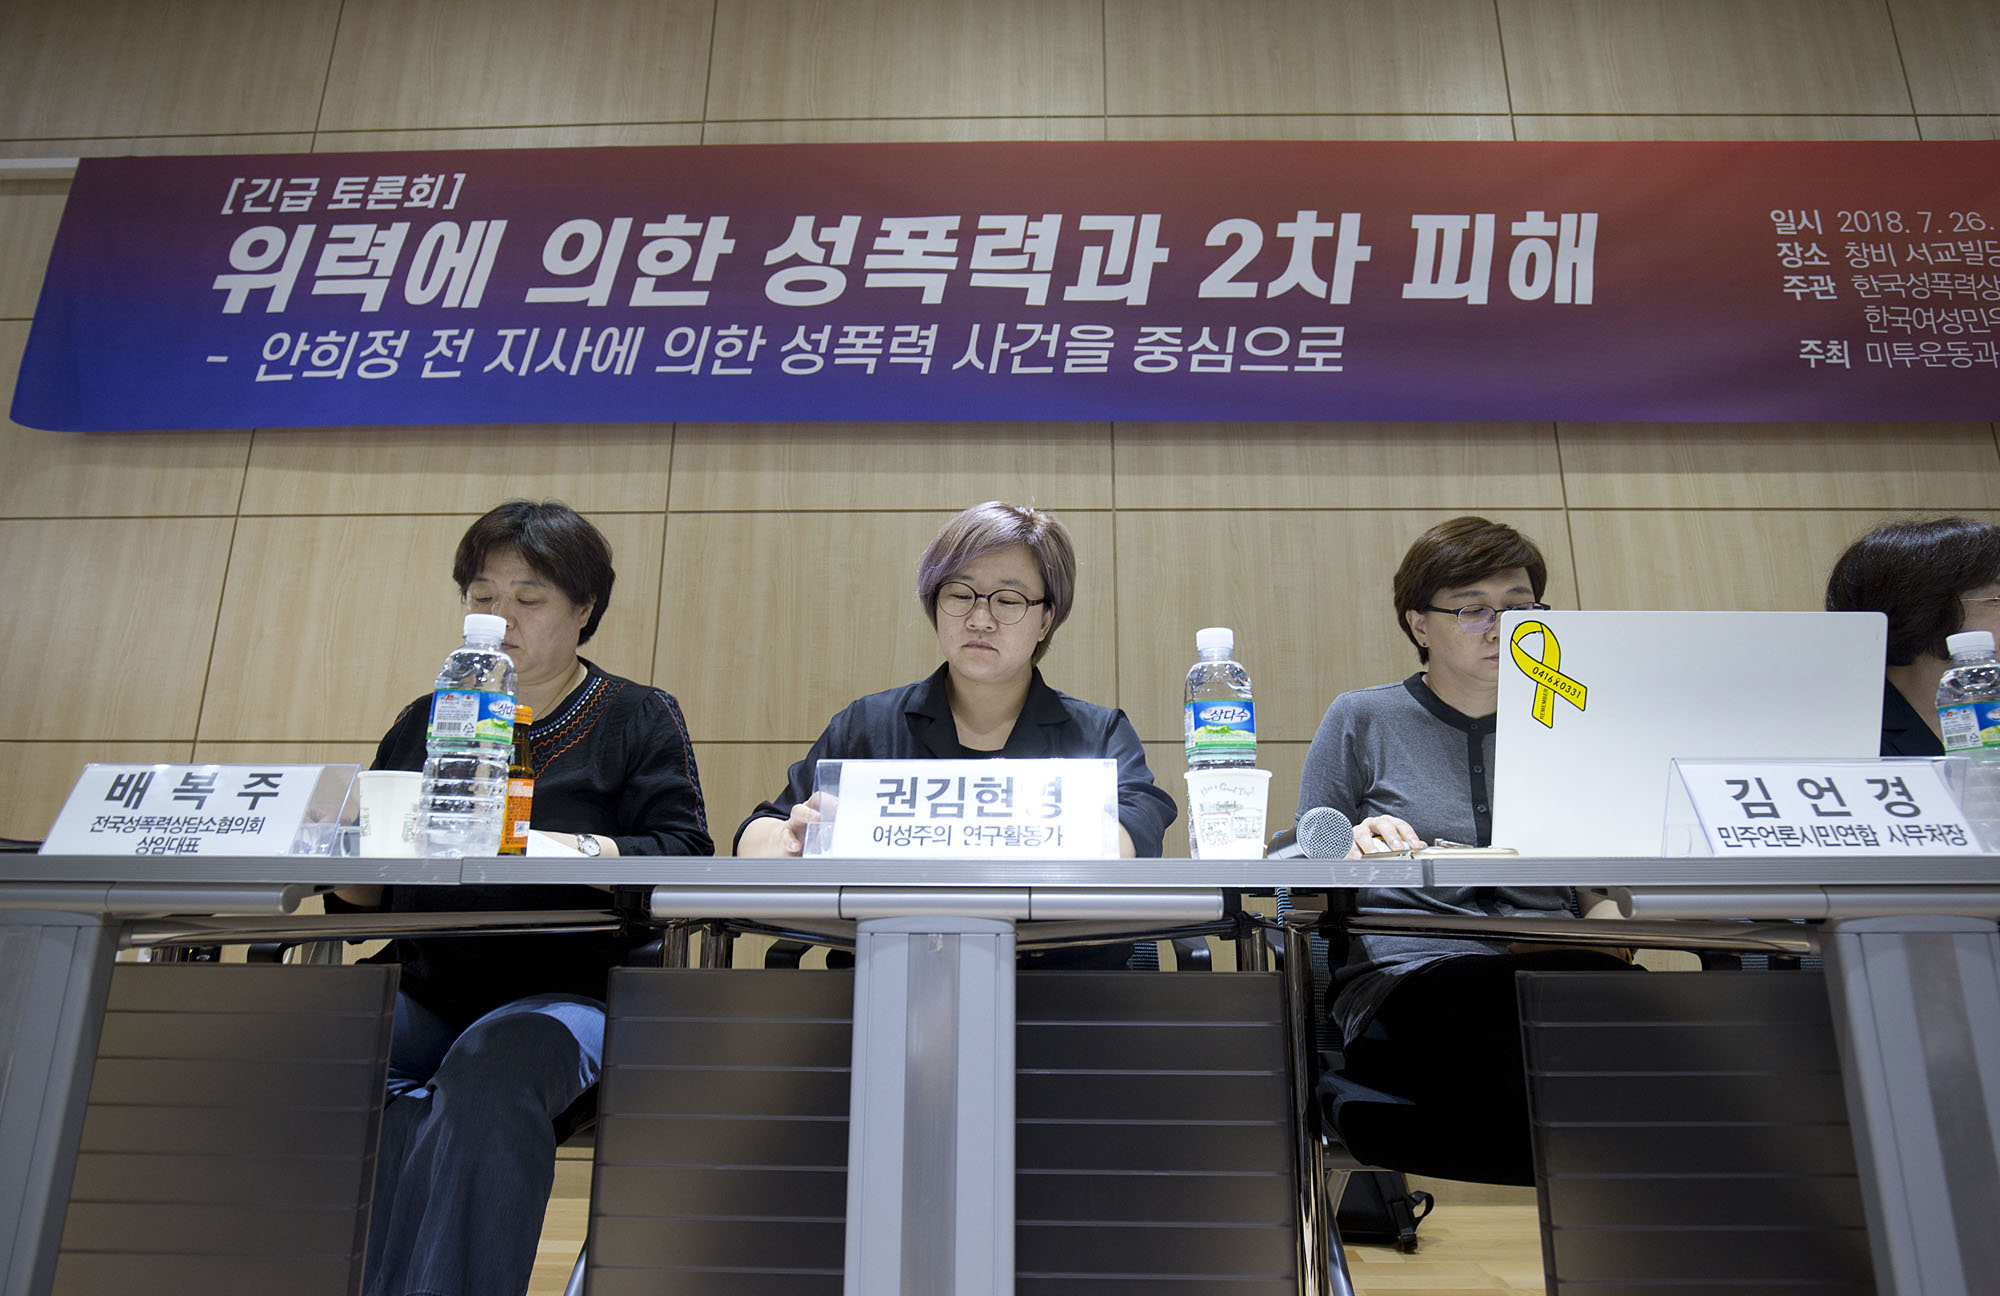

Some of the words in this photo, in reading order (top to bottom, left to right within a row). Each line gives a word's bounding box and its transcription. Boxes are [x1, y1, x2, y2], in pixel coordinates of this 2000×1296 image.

[222, 178, 319, 215] [긴급
[328, 173, 466, 210] 토론회]
[1769, 209, 1823, 235] 일시
[1837, 210, 1910, 233] 2018.
[1949, 211, 1995, 233] 26.
[212, 219, 508, 314] 위력에
[524, 214, 736, 307] 의한
[763, 213, 1170, 307] 성폭력과
[1197, 210, 1372, 305] 2차
[1402, 210, 1599, 305] 피해
[1776, 241, 1831, 269] 장소
[1844, 241, 1898, 269] 창비
[1783, 274, 1838, 301] 주관
[255, 329, 410, 382] 안희정
[421, 328, 475, 379] 전
[483, 326, 645, 377] 지사에
[655, 324, 767, 375] 의한
[780, 323, 939, 375] 성폭력
[951, 322, 1115, 375] 사건을
[1133, 326, 1345, 373] 중심으로
[1799, 339, 1851, 369] 주최
[1866, 341, 2000, 369] 미투운동과
[1210, 708, 1248, 721] 삼다수
[90, 815, 266, 835] 전국성폭력상담소협의회
[873, 824, 952, 847] 여성주의
[963, 824, 1064, 847] 연구활동가
[1717, 824, 1880, 848] 민주언론시민연합
[1888, 824, 1968, 847] 사무처장
[136, 836, 201, 854] 상임대표
